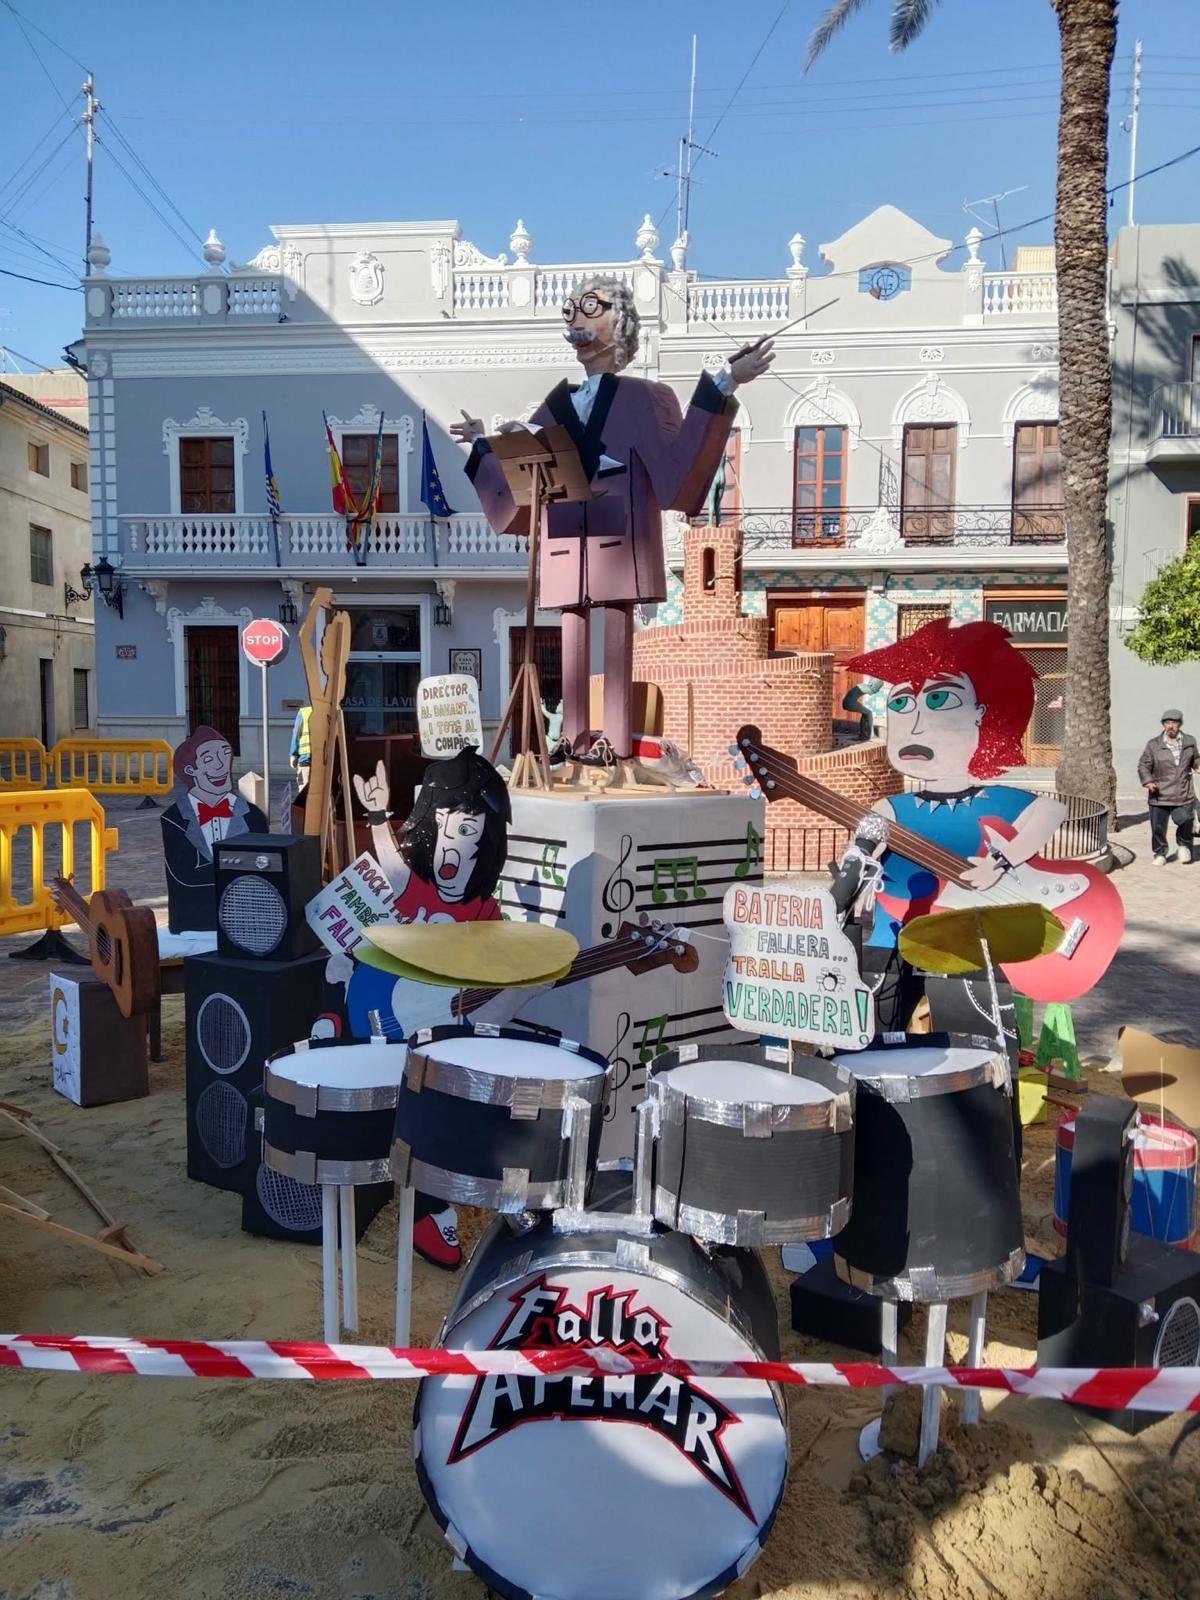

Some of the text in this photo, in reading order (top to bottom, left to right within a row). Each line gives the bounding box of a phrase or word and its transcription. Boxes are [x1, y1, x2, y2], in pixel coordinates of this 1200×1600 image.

[245, 635, 280, 646] STOP
[341, 696, 366, 706] ASA
[384, 696, 400, 706] LA
[422, 682, 469, 701] DIRECTOR
[353, 858, 390, 897] ROCK
[733, 889, 824, 930] BATERIA
[732, 955, 806, 983] TRALLA
[726, 980, 870, 1046] VERDADERA!
[495, 1286, 662, 1348] Falla
